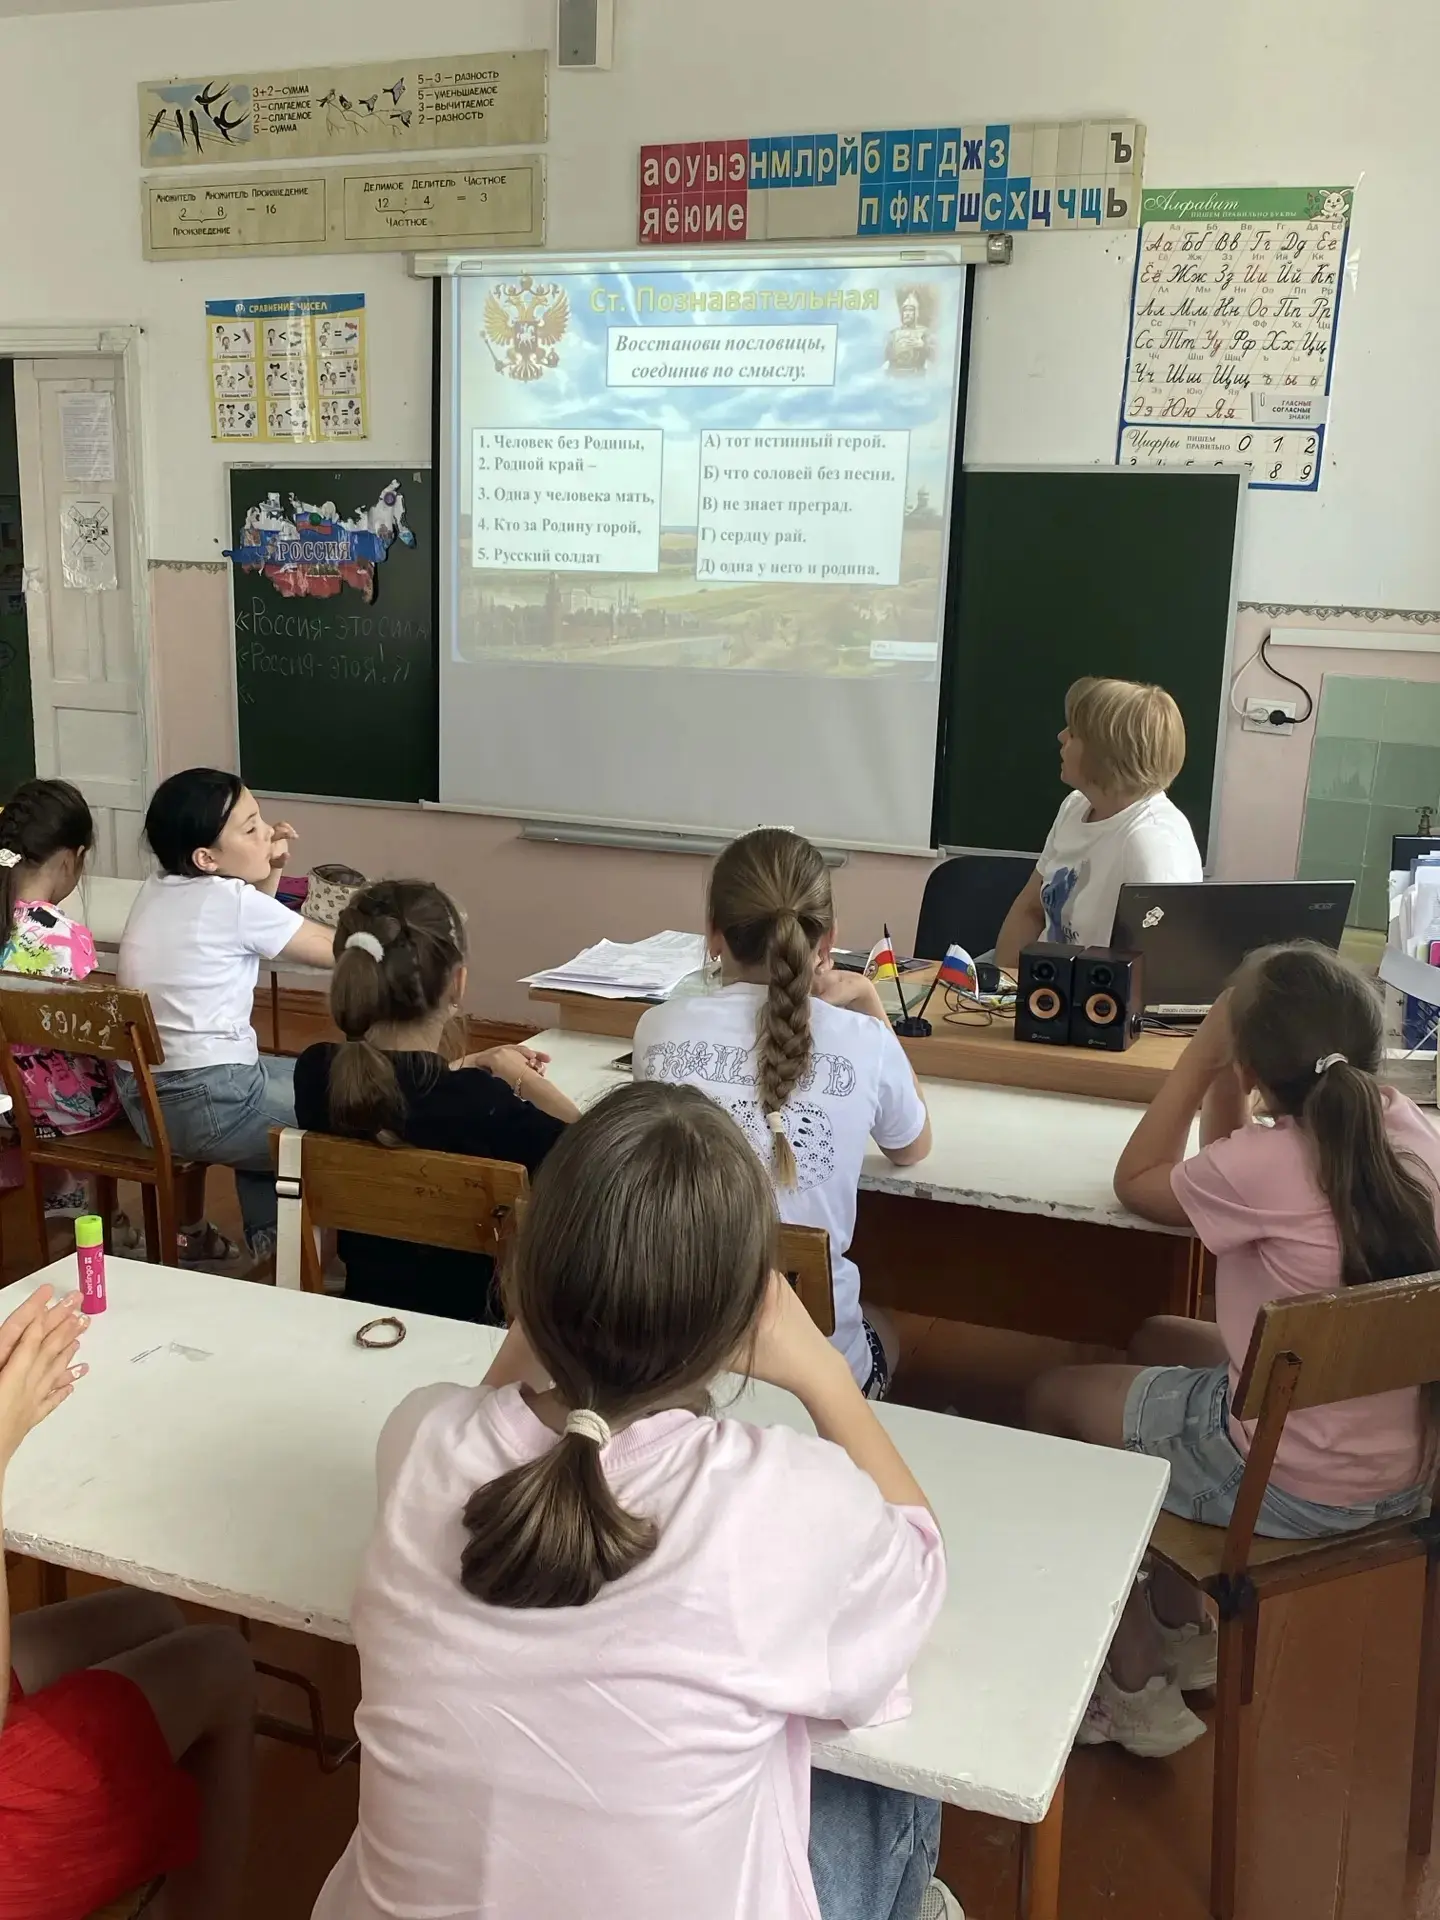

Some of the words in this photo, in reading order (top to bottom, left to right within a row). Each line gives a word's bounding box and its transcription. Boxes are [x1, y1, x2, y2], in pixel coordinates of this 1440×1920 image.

[378, 198, 389, 208] 12
[423, 195, 430, 205] 4
[480, 192, 488, 202] 3
[1144, 190, 1240, 218] Алфавит
[386, 217, 427, 227] ЧАСТНОЕ
[249, 301, 295, 313] СРАВНЕНИЕ
[297, 301, 328, 311] ЧИСЕЛ
[590, 288, 626, 312] Ст.
[636, 287, 879, 312] Познавательная
[615, 334, 720, 352] Восстанови
[724, 336, 826, 354] пословицы,
[631, 361, 709, 378] соединив
[713, 366, 732, 378] по
[494, 435, 553, 449] Человек
[557, 436, 580, 450] без
[583, 436, 645, 451] Родины,
[725, 437, 750, 448] тот
[754, 433, 833, 448] истинный
[836, 435, 886, 451] герой.
[1127, 430, 1180, 456] Цифры
[1186, 443, 1231, 451] ПРАВИЛЬНО
[1238, 435, 1252, 452] 0
[1272, 436, 1284, 453] 1
[1304, 437, 1316, 454] 2
[494, 457, 544, 471] Родной
[548, 458, 584, 474] край
[724, 469, 749, 480] что
[753, 467, 813, 480] соловей
[817, 466, 840, 480] без
[844, 470, 895, 481] песни.
[1269, 463, 1282, 479] 8
[1300, 464, 1312, 480] 9
[494, 487, 530, 502] Одна
[534, 491, 541, 504] у
[546, 491, 611, 502] человека
[615, 493, 655, 505] мать,
[723, 500, 740, 511] не
[744, 500, 784, 511] знает
[788, 500, 853, 515] преград.
[494, 518, 520, 531] Кто
[524, 521, 537, 531] за
[542, 518, 594, 536] Родину
[597, 521, 642, 537] горой,
[720, 529, 770, 545] сердцу
[775, 530, 807, 543] рай.
[277, 541, 351, 561] РОССИЯ
[494, 548, 551, 564] Русский
[554, 552, 601, 564] солдат
[720, 562, 754, 575] одна
[758, 563, 766, 576] у
[770, 564, 802, 574] него
[808, 564, 817, 574] и
[821, 565, 880, 578] родина.
[645, 1040, 856, 1098] THAILD
